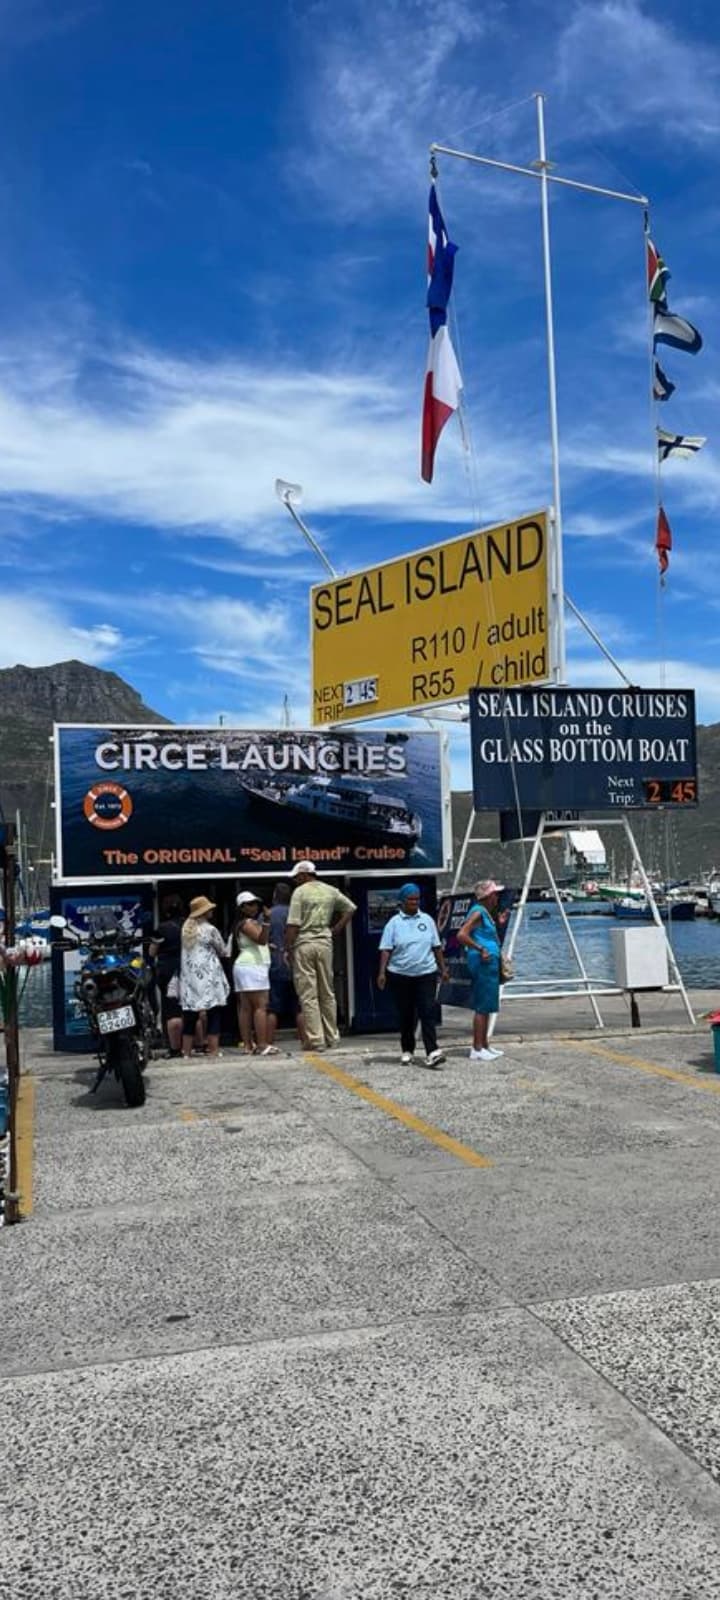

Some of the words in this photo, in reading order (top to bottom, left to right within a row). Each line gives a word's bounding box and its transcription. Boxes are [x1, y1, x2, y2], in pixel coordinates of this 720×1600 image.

[314, 571, 395, 631] SEAL
[405, 521, 544, 605] ISLAND
[411, 627, 465, 664] R110
[472, 621, 480, 651] /
[487, 606, 545, 646] adult
[412, 668, 455, 701] R55
[490, 648, 546, 686] child
[314, 683, 344, 703] NEXT
[360, 681, 376, 700] 45
[317, 703, 344, 722] TRIP
[477, 692, 528, 718] SEAL
[533, 692, 603, 718] ISLAND
[607, 693, 688, 718] CRUISES
[559, 724, 580, 736] on
[585, 720, 613, 736] the
[94, 742, 209, 770] CIRCE
[219, 743, 407, 771] LAUNCHES
[480, 738, 545, 763] GLASS
[550, 738, 633, 763] BOTTOM
[639, 738, 689, 762] BOAT
[607, 776, 634, 788] Next
[648, 782, 661, 802] 2
[671, 782, 696, 802] 45
[608, 791, 635, 805] Trip:
[103, 850, 139, 865] The
[143, 848, 237, 864] ORIGINAL
[354, 845, 406, 860] Cruise
